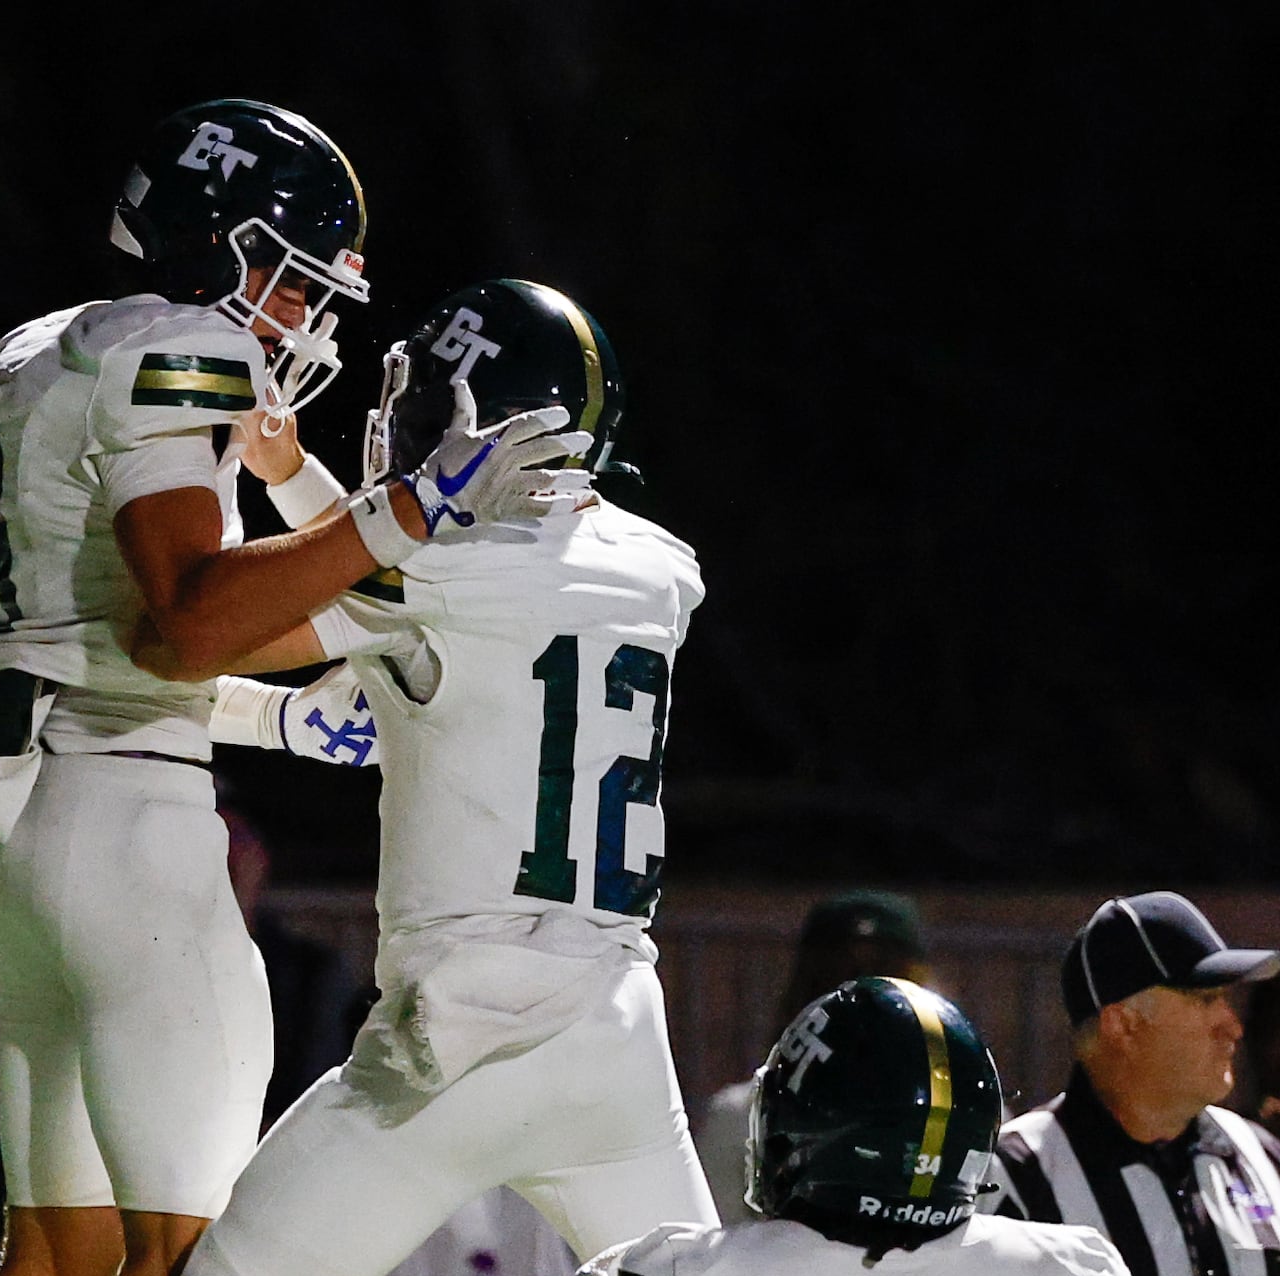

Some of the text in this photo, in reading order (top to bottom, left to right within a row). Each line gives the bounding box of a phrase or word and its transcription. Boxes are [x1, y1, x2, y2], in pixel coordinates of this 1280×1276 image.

[513, 634, 669, 918] 12
[914, 1153, 942, 1177] 34
[858, 1195, 964, 1228] Riddell
